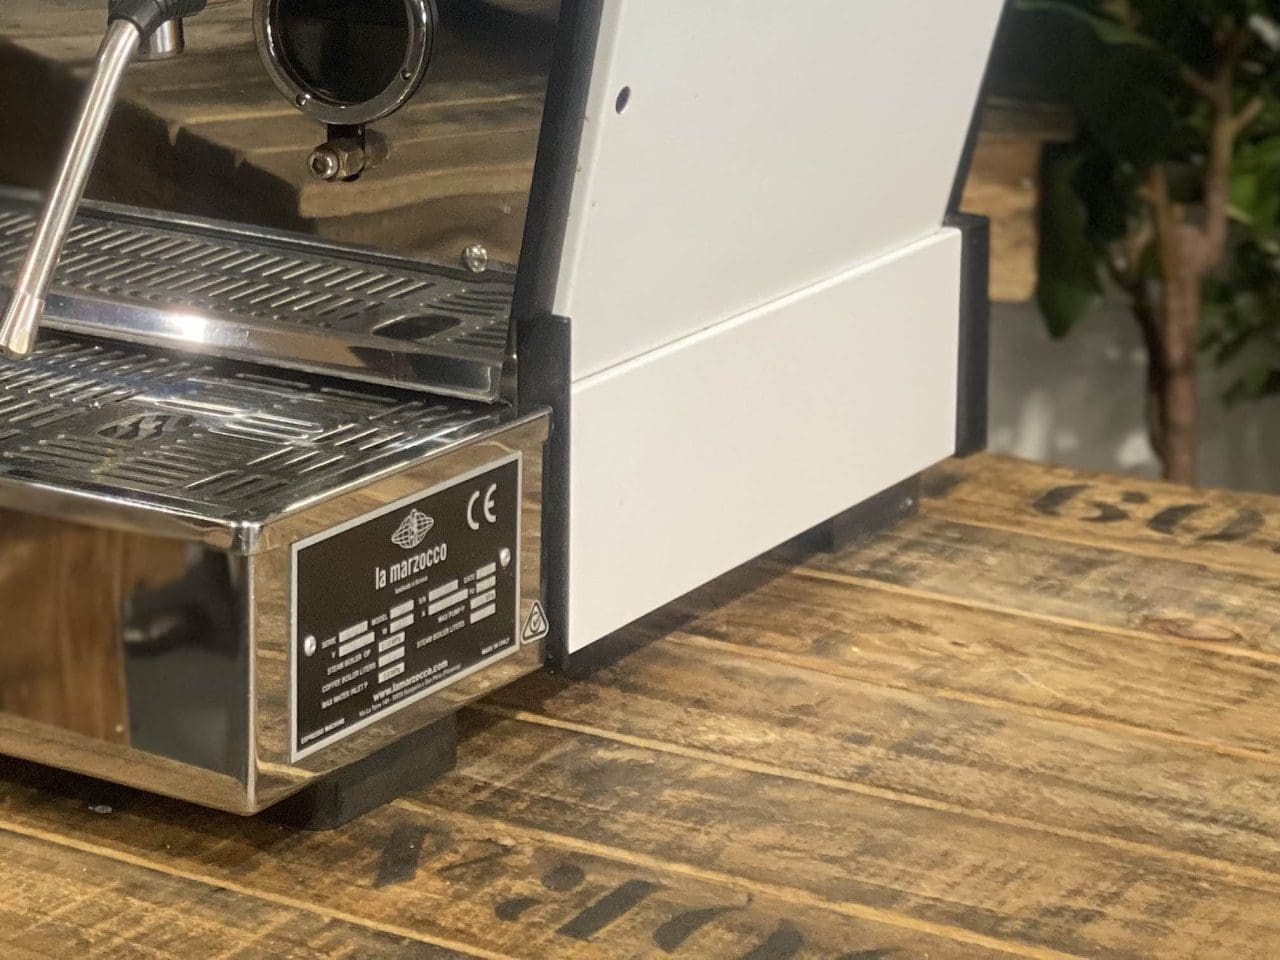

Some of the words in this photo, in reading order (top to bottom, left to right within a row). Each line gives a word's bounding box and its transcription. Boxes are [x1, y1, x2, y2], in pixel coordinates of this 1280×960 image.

[466, 483, 498, 530] CE
[375, 566, 387, 590] la
[389, 542, 448, 584] marzocco
